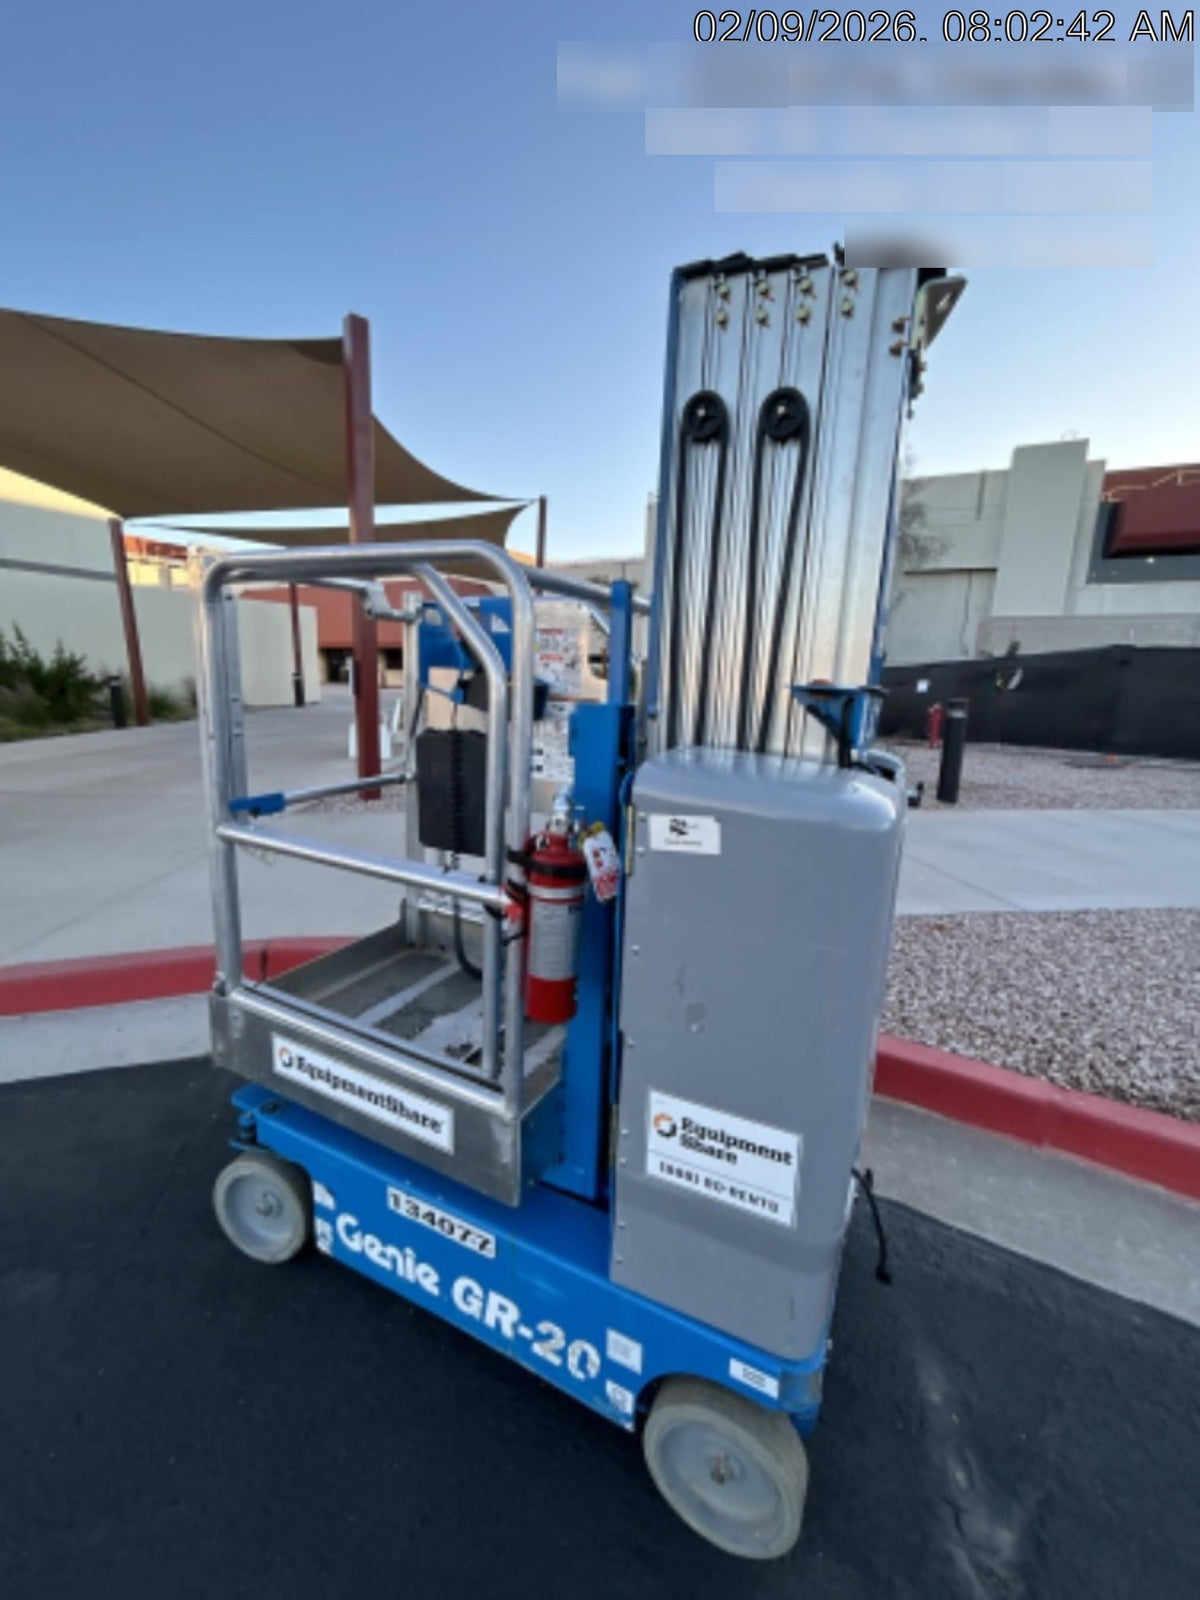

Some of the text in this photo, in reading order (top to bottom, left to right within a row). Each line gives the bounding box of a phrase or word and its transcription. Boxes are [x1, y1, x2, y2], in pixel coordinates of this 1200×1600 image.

[296, 1056, 443, 1134] EquipmentShare
[680, 1132, 738, 1165] Share
[681, 1117, 795, 1166] Equipment
[391, 1192, 491, 1251] 134077
[336, 1213, 600, 1380] Genie GR-20
